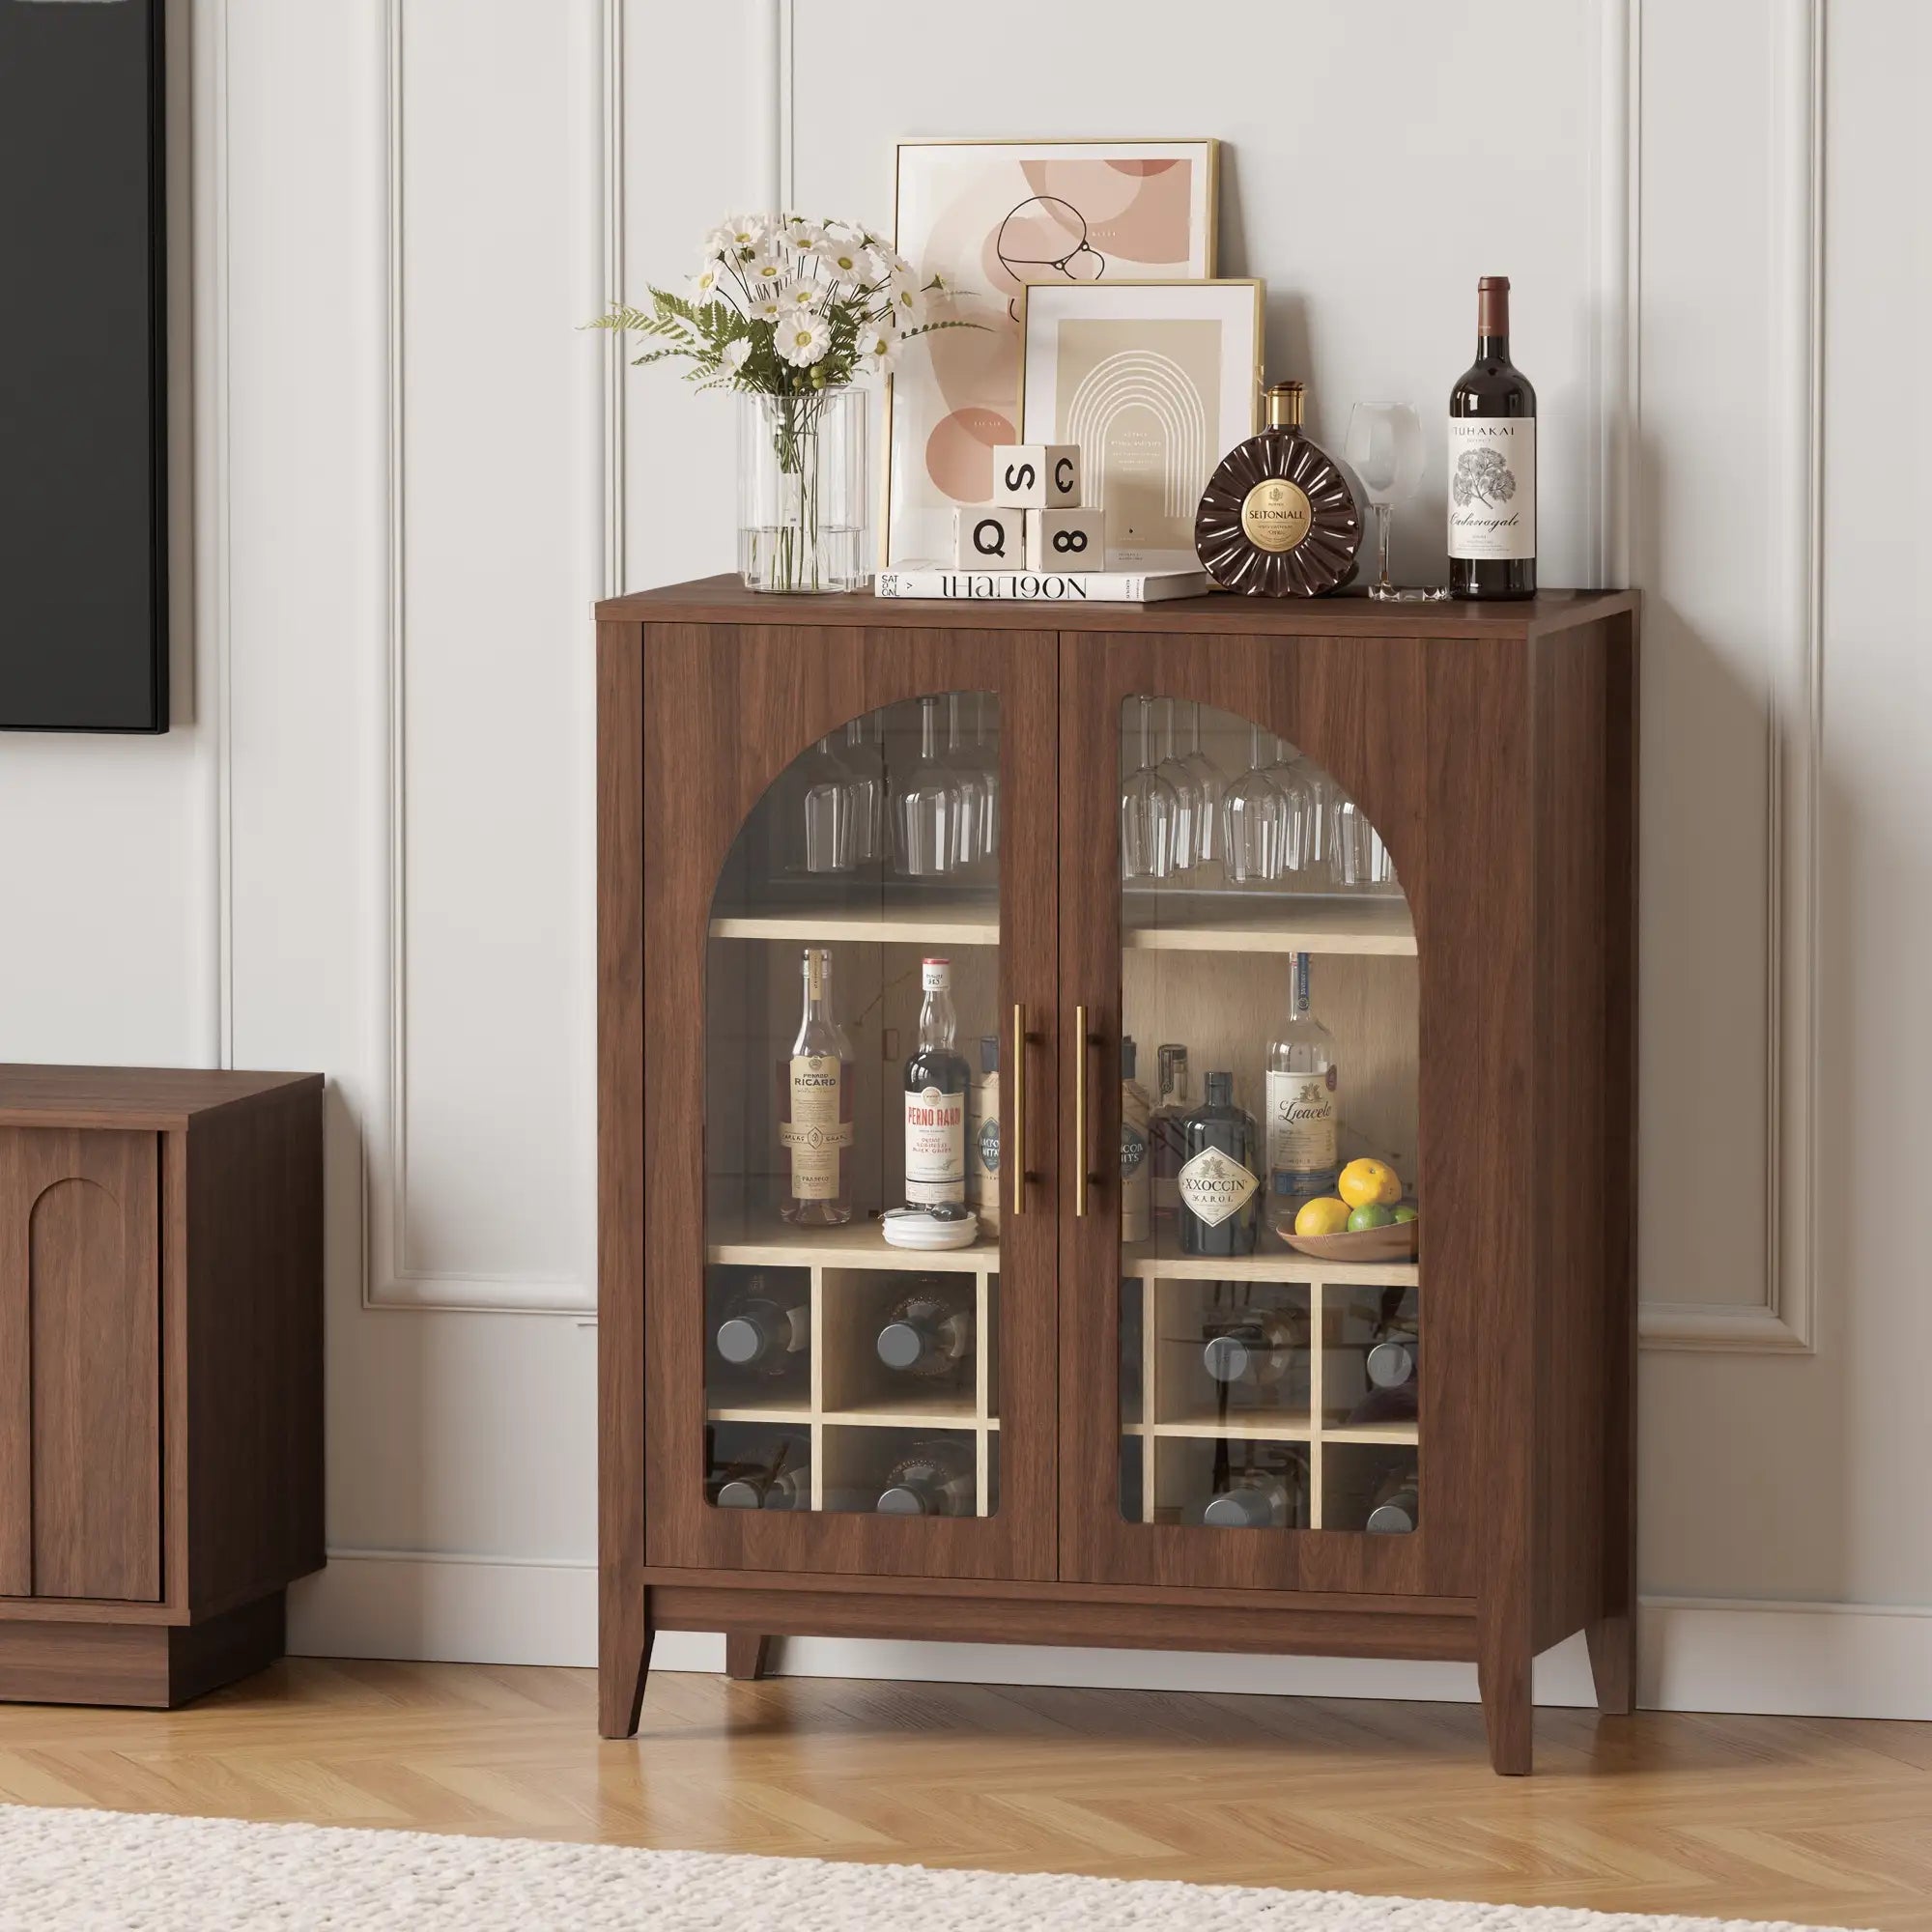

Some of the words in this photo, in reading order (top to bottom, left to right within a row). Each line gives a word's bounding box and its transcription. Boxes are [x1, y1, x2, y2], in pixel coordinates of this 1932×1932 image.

[1005, 464, 1036, 492] S
[973, 519, 1006, 558] Q
[1052, 529, 1088, 554] 8
[794, 1077, 837, 1087] RICARD
